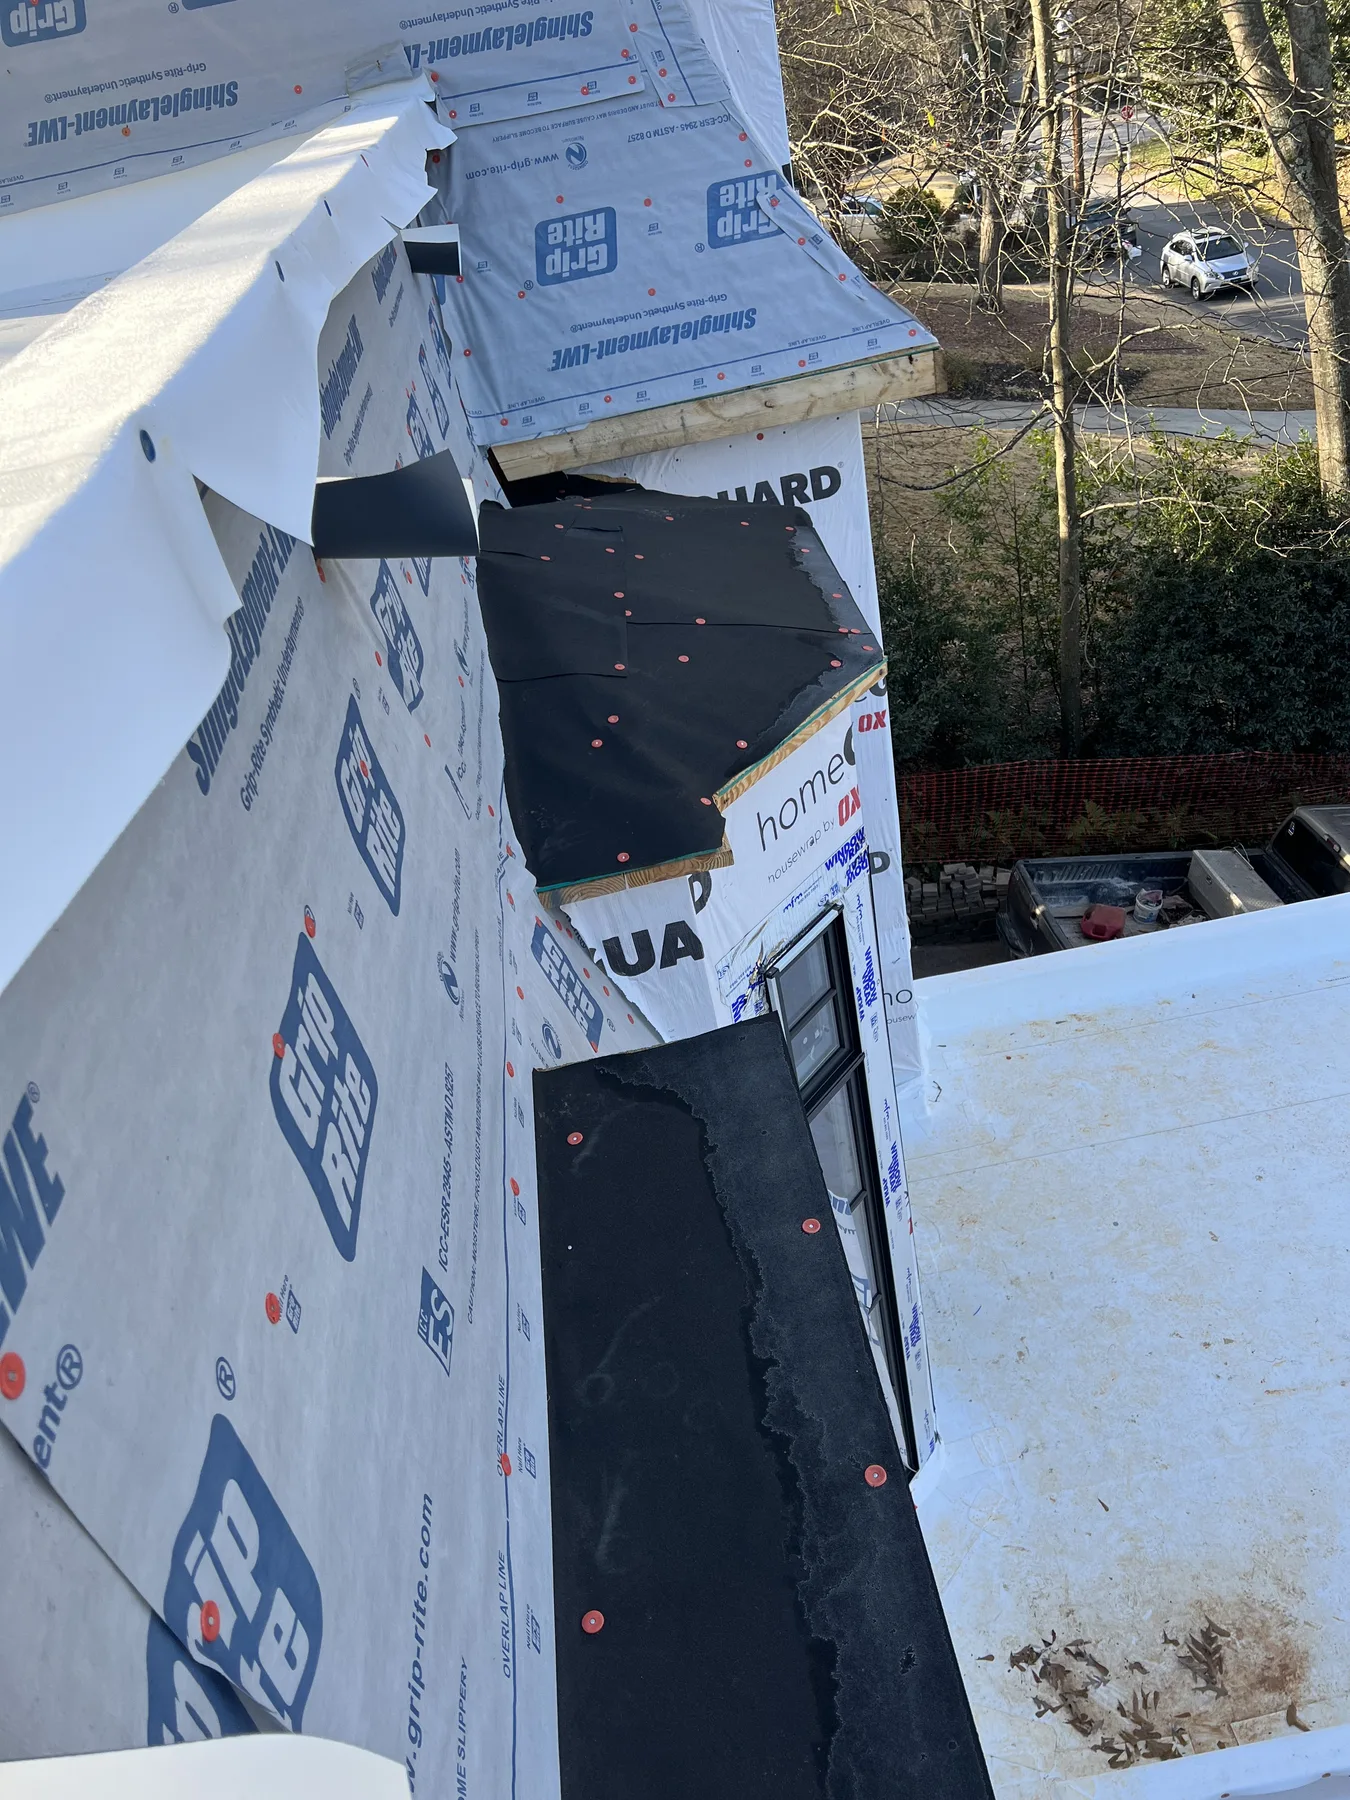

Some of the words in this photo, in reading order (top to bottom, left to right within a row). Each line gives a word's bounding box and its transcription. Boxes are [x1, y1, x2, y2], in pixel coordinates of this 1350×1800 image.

[9, 0, 77, 36] Grip
[476, 0, 521, 16] Synthetic
[119, 70, 163, 88] Synthetic
[164, 62, 207, 80] Grip-Rite
[627, 133, 645, 144] 8257
[652, 125, 675, 138] ASTM
[680, 120, 698, 132] 2945
[465, 152, 559, 181] www.grip-rite.com
[546, 212, 607, 245] Rite
[545, 243, 608, 279] Grip
[643, 301, 686, 319] Synthetic
[687, 293, 728, 308] Grip-Rite
[801, 334, 827, 346] OVERLAP
[851, 325, 865, 334] LINE
[865, 318, 891, 331] OVERLAP
[788, 340, 801, 348] LINE
[507, 401, 520, 410] LINE
[520, 396, 546, 408] OVERLAP
[858, 710, 887, 733] OX
[240, 738, 272, 812] Grip-Rite
[260, 676, 290, 740] Synthetic
[366, 788, 401, 899] Rite
[767, 829, 822, 884] housewrap
[823, 817, 836, 833] by
[825, 827, 866, 871] WINDOW
[542, 933, 595, 1020] Grip
[863, 946, 877, 1002] WINDOW
[540, 955, 587, 1035] Rite
[474, 1000, 482, 1038] SURFACE
[279, 973, 339, 1150] Grip
[475, 1037, 483, 1066] CAUSE
[445, 1062, 455, 1097] 8257
[320, 1052, 371, 1232] Rite
[444, 1109, 454, 1155] ASTM
[443, 1157, 452, 1199] 2945
[438, 1196, 451, 1274] ICC-ESR
[280, 1274, 288, 1298] Here
[467, 1264, 477, 1325] CAUTION:
[417, 1308, 428, 1340] ICC
[428, 1288, 454, 1373] ES
[497, 1374, 506, 1409] LINE
[496, 1406, 505, 1478] OVERLAP
[498, 1549, 507, 1591] LINE
[500, 1591, 512, 1680] OVERLAP
[457, 1655, 469, 1760] SLIPPERY
